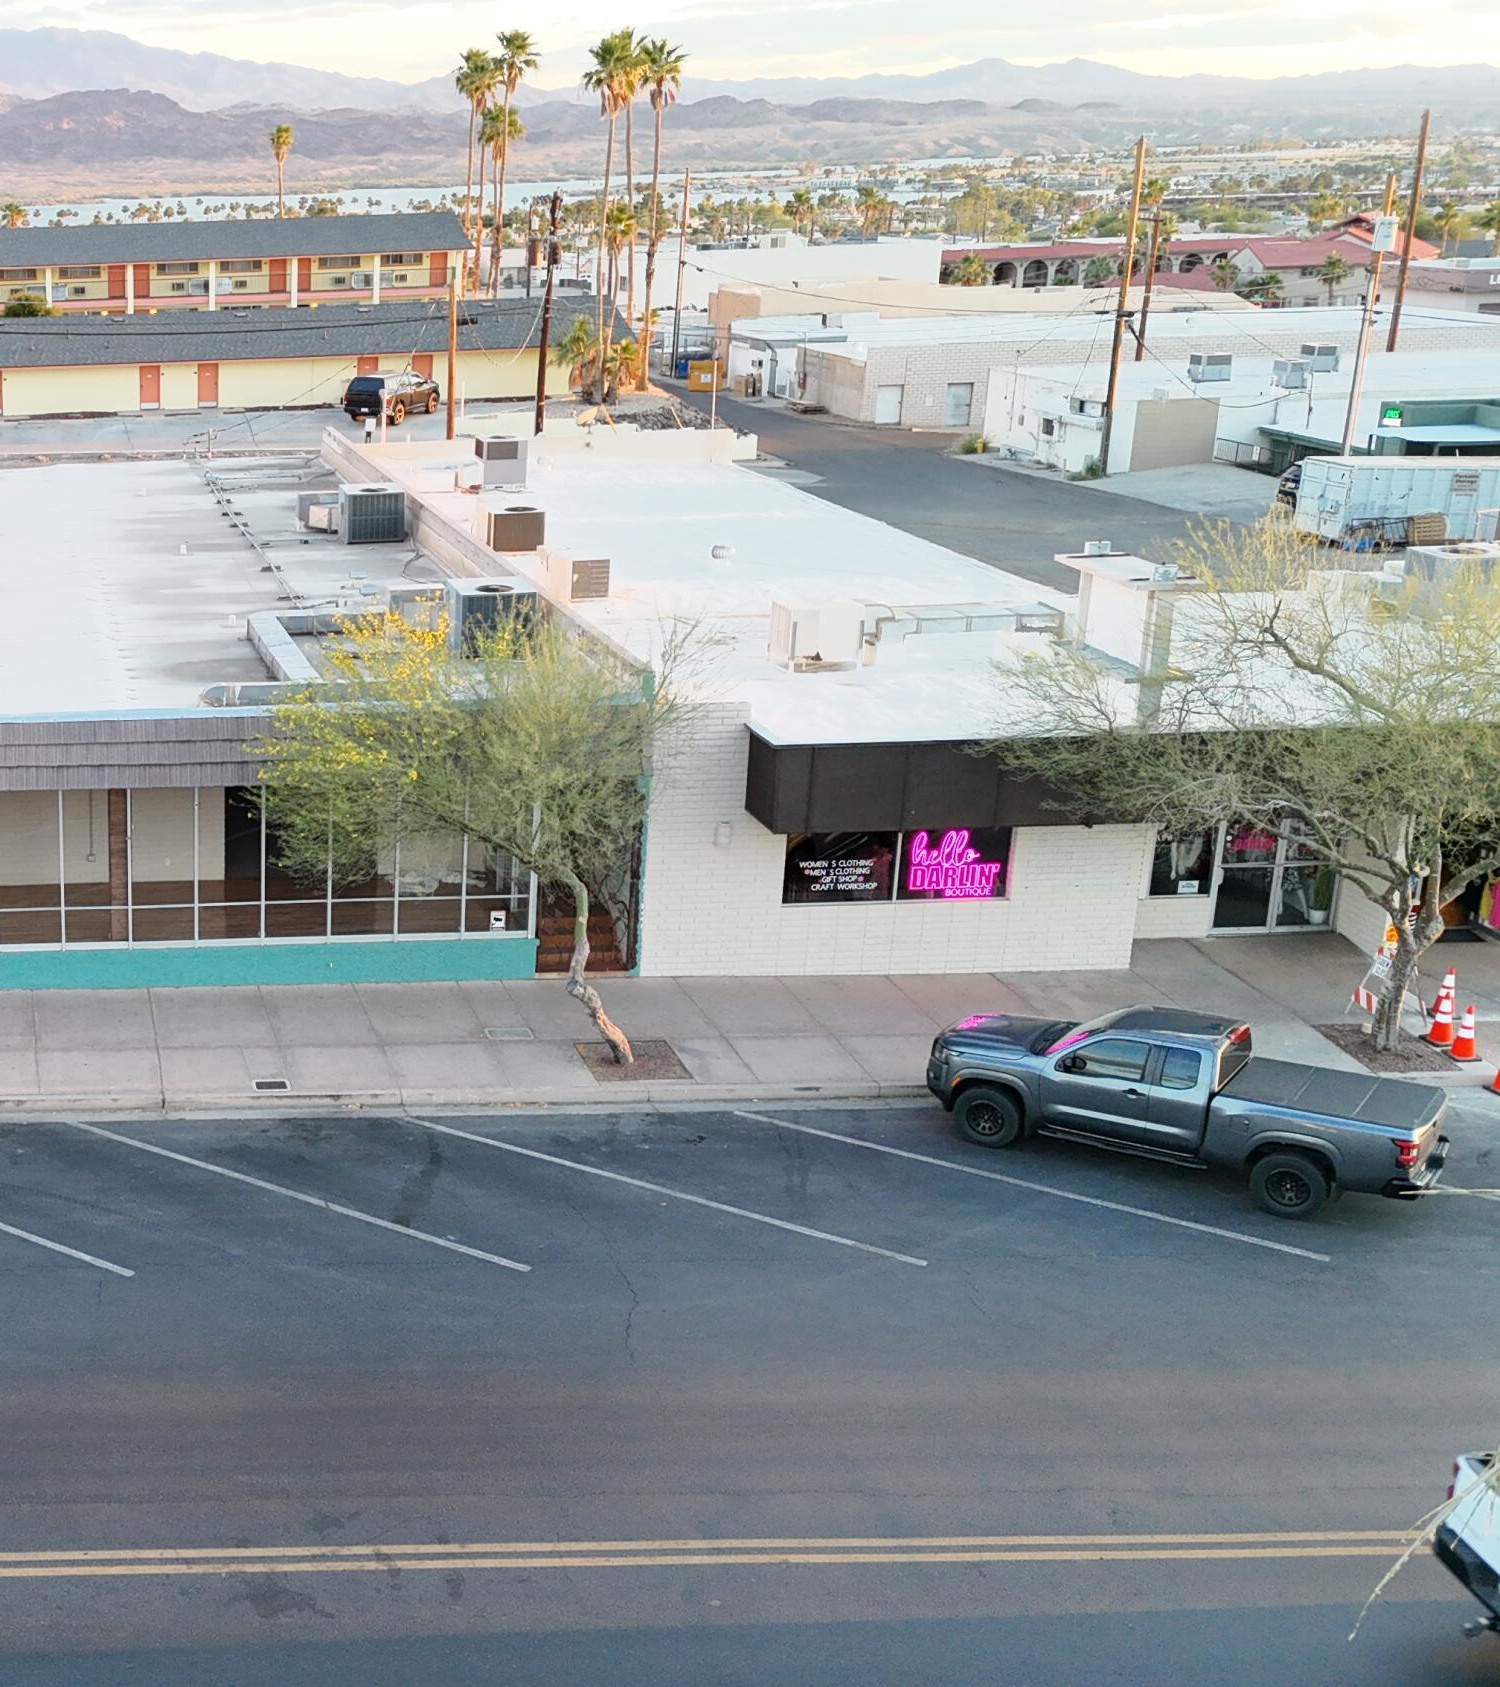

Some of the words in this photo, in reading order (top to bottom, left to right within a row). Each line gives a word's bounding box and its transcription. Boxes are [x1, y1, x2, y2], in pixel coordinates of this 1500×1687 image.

[911, 830, 980, 866] hello
[838, 859, 874, 867] CLOTHING
[835, 867, 870, 875] CLOTHING
[821, 875, 837, 883] GIFT
[811, 883, 835, 891] CRAFT
[836, 882, 878, 890] WORKSHOP
[945, 887, 992, 896] BOUTIQUE
